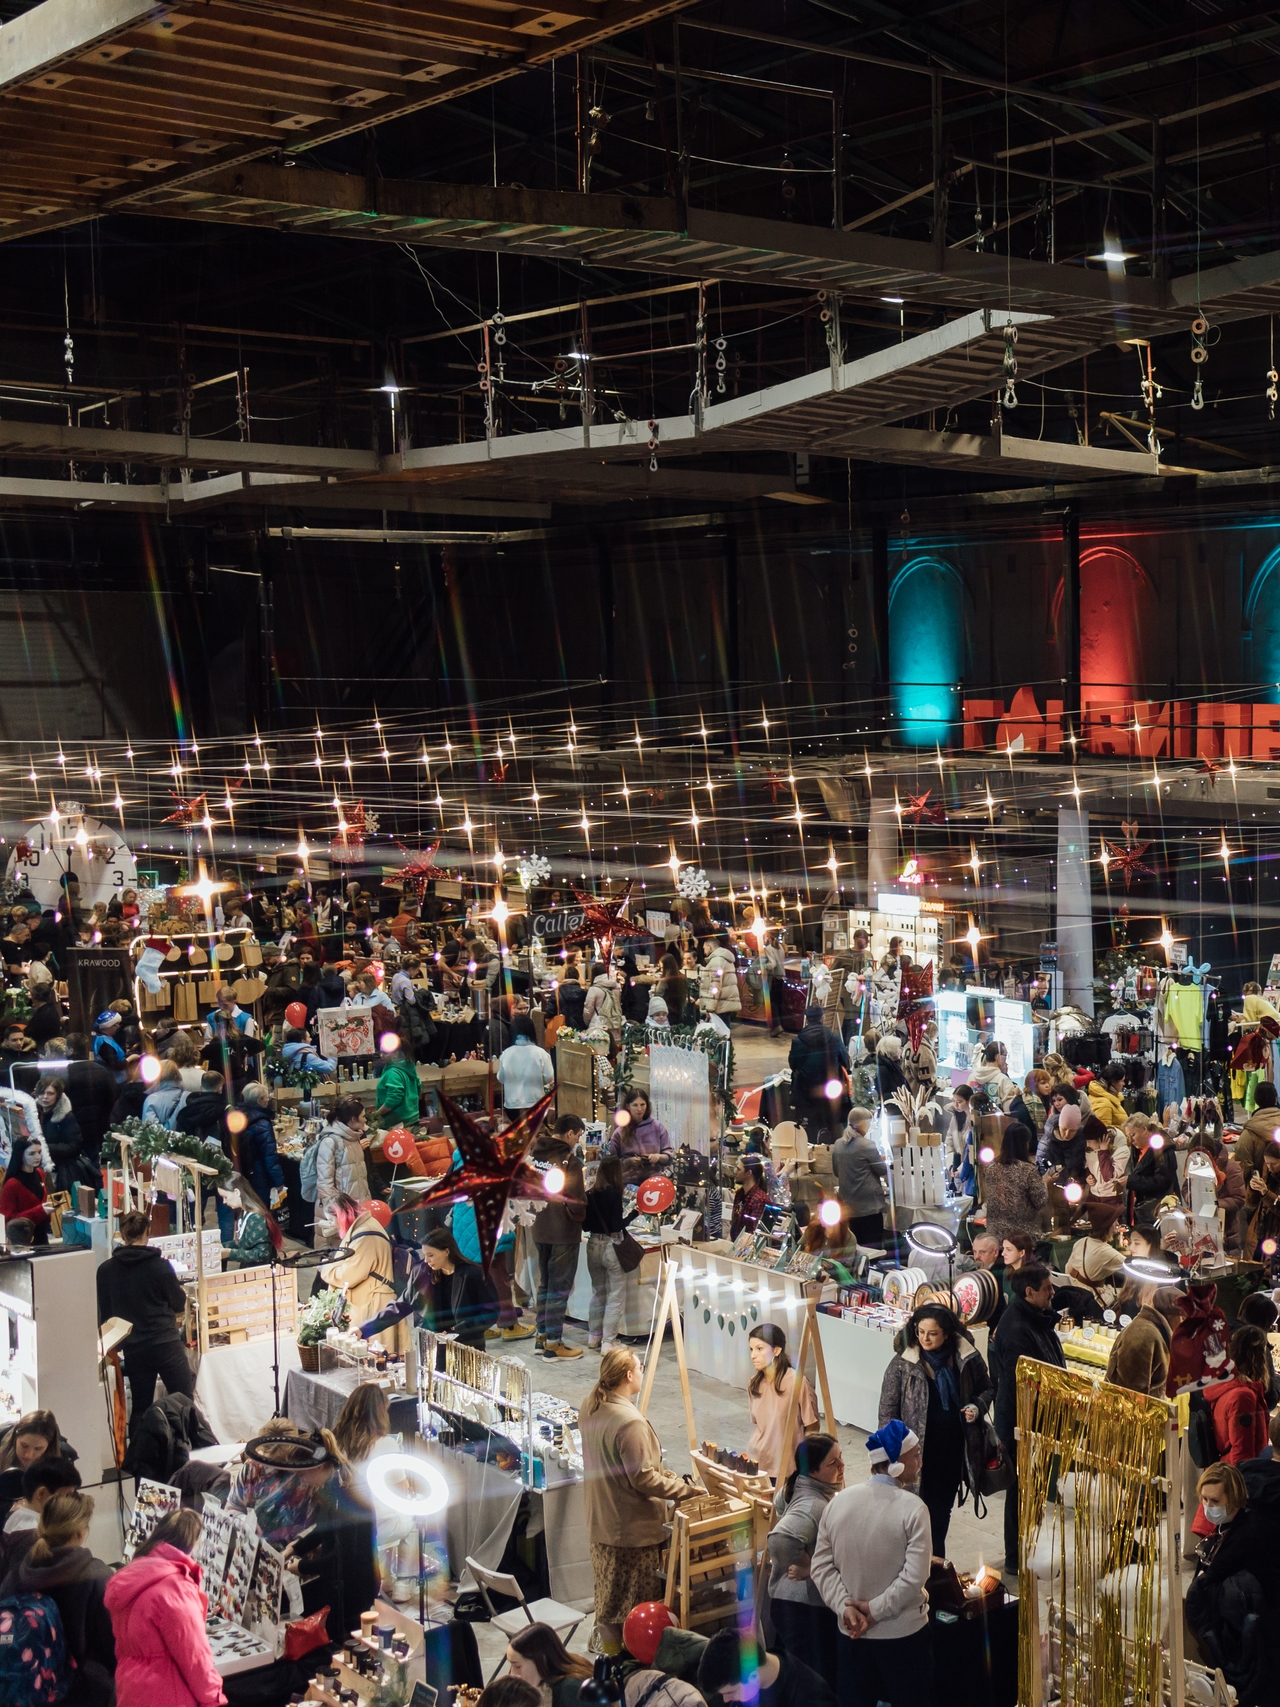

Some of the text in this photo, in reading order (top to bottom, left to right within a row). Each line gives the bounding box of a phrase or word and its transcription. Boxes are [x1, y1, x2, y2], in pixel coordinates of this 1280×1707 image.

[40, 832, 54, 850] 11
[23, 850, 40, 867] 0
[105, 847, 116, 864] 2
[112, 870, 124, 887] 3
[78, 959, 121, 968] KRAWOOD
